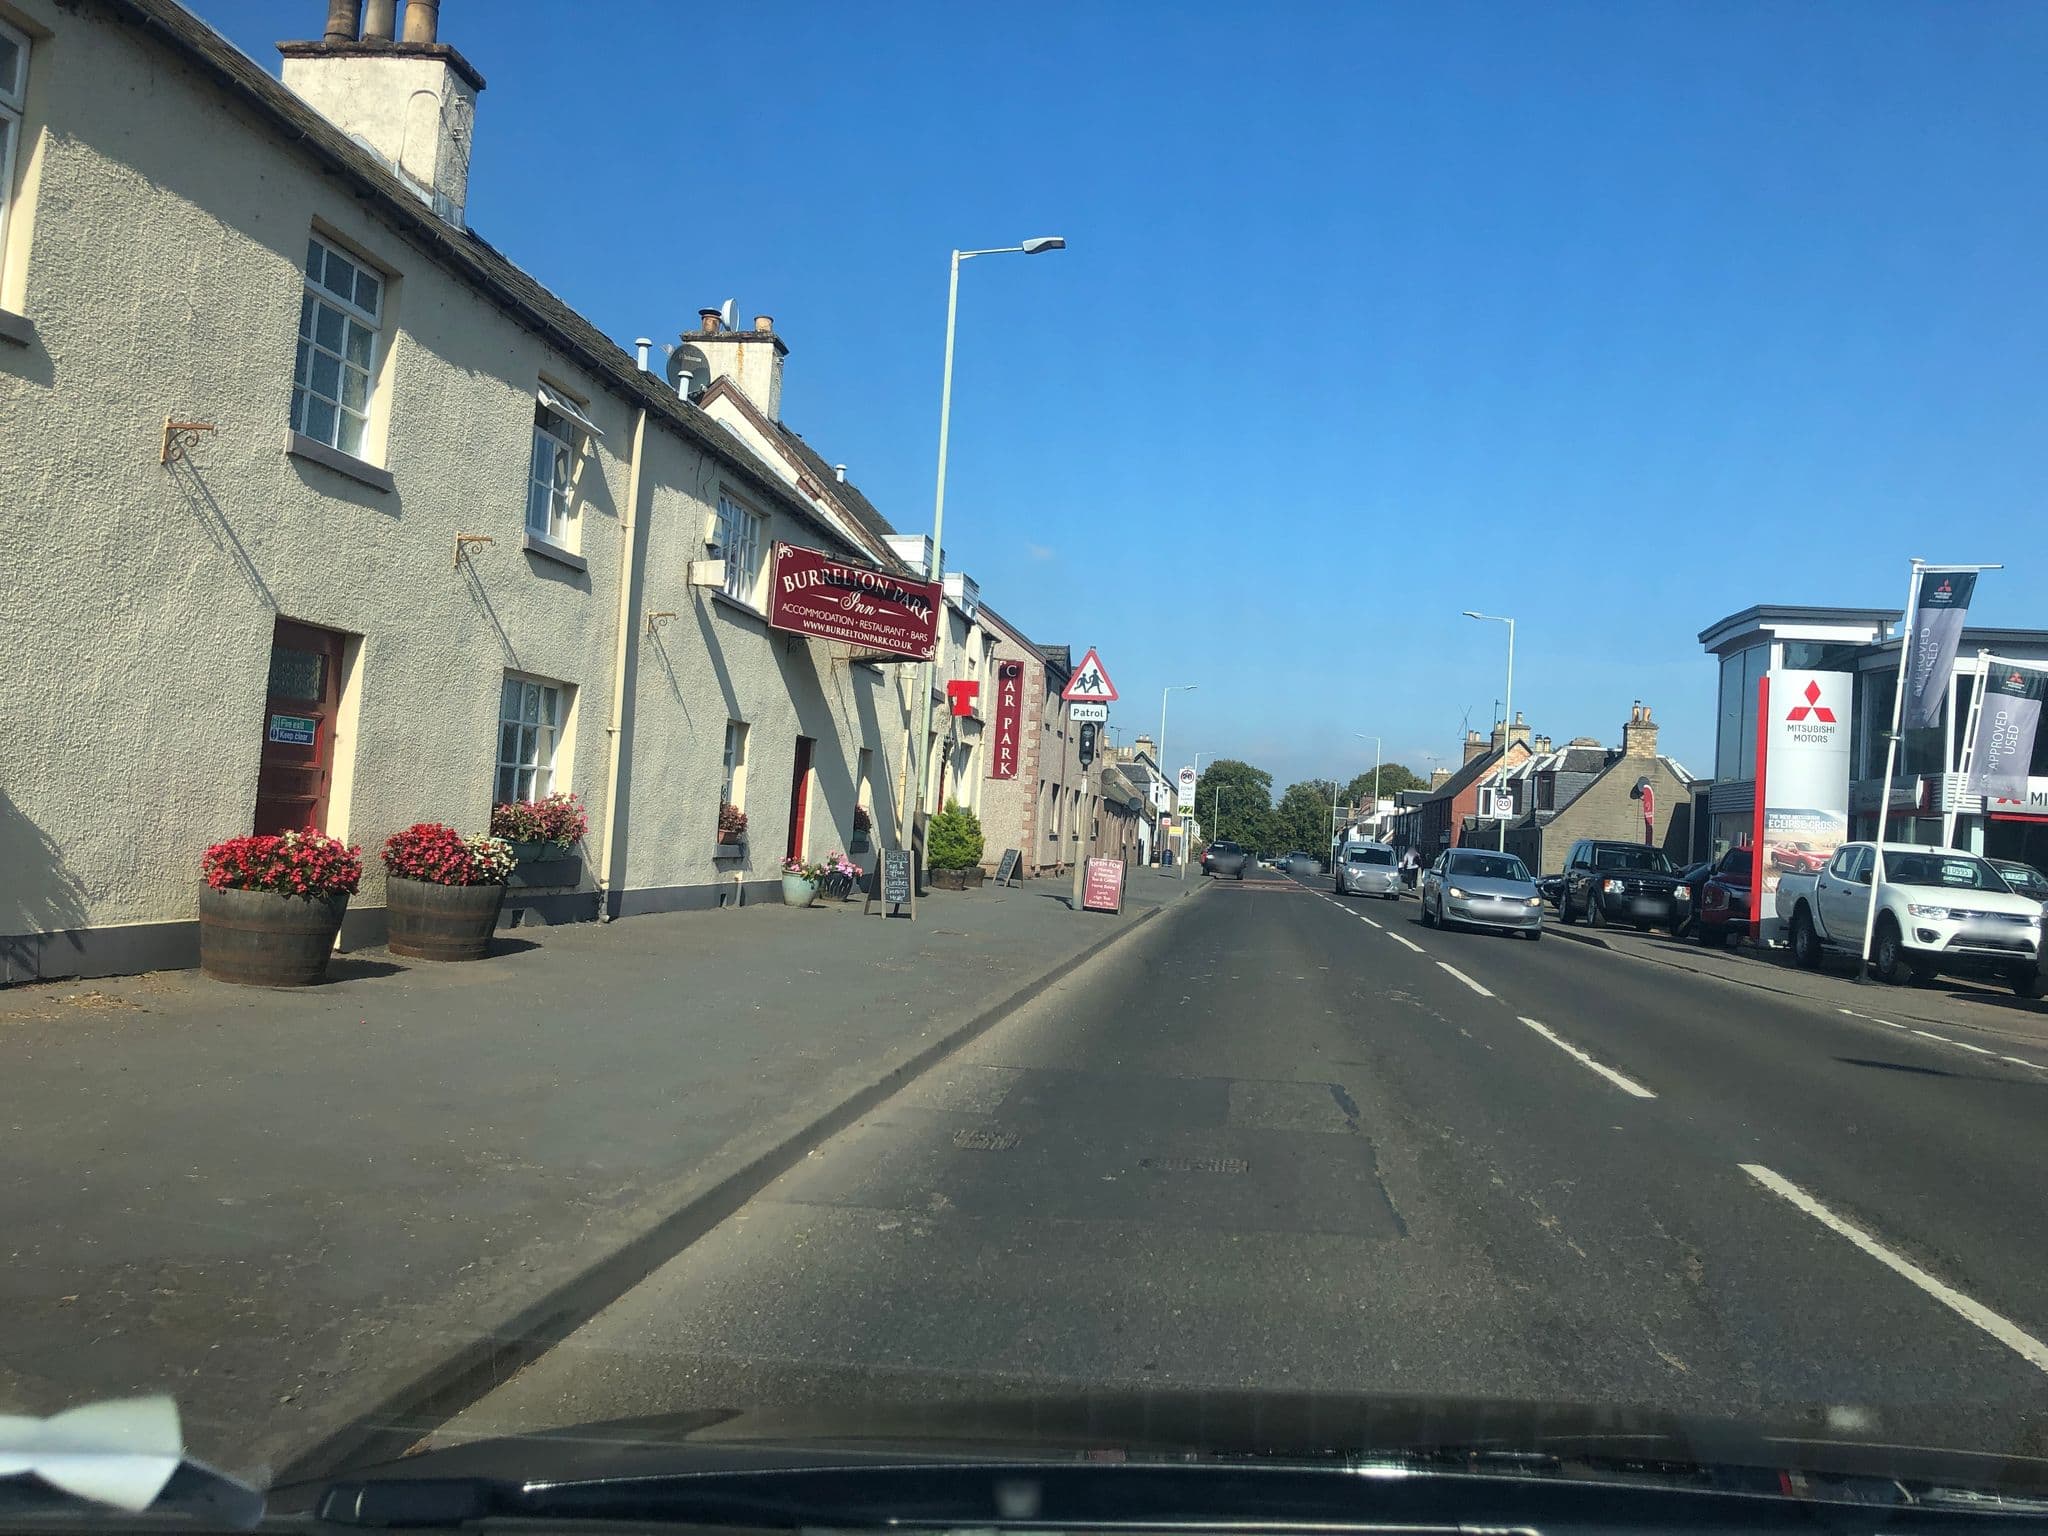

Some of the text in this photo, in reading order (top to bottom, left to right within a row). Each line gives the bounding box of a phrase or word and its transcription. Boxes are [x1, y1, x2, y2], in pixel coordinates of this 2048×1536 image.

[783, 568, 933, 625] BURRELTON PARK
[840, 590, 876, 616] Inn
[782, 603, 928, 642] ACCOMMODATION RESTAURANT BARS
[803, 620, 913, 650] WWW.BURRELTONPARK.CO.UK
[1000, 665, 1017, 775] CAR PARK
[1073, 708, 1103, 718] Patrol
[280, 731, 294, 740] Keep
[1787, 724, 1835, 734] MITSUBISHI
[1793, 734, 1828, 743] MOTORS
[1989, 711, 2008, 769] APPROVED
[2004, 725, 2019, 755] USED
[1769, 819, 1838, 830] ECLIPSE CROSS
